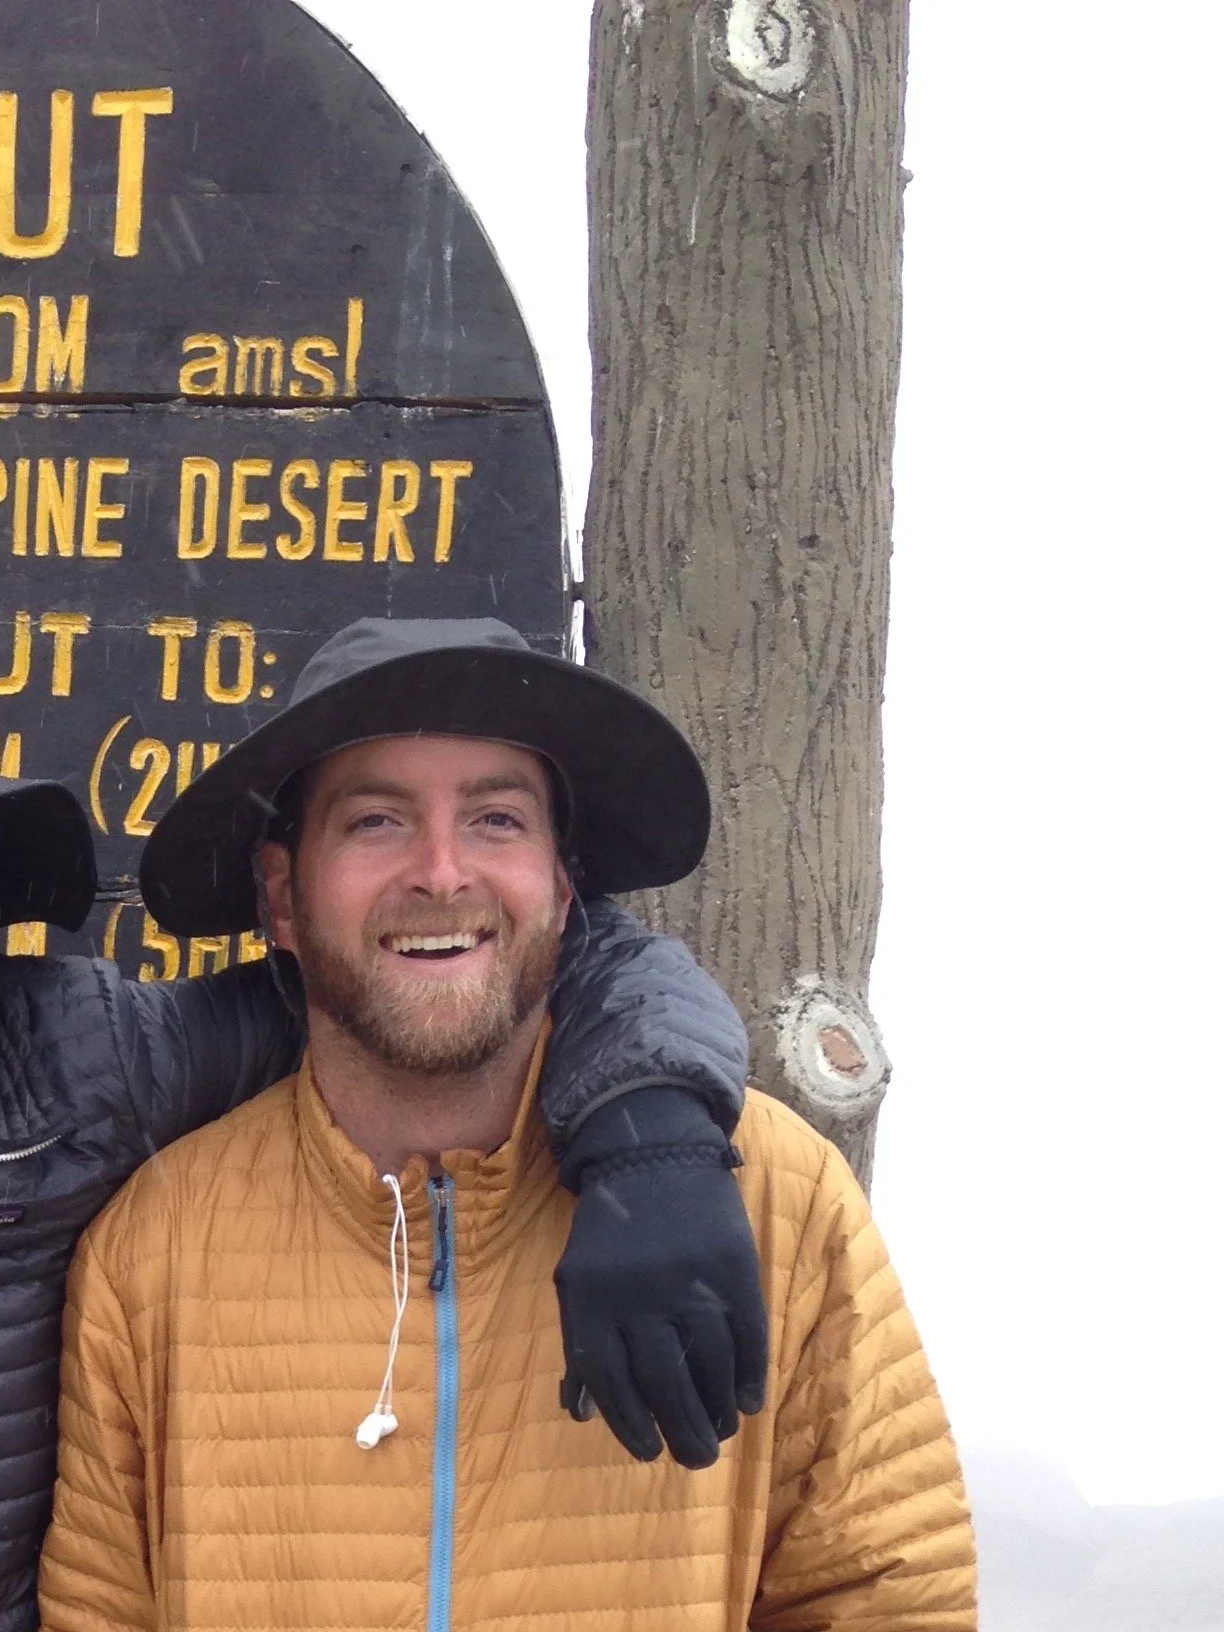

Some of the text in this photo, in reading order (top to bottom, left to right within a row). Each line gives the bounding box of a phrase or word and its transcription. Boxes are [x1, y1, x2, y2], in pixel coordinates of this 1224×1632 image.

[178, 298, 364, 402] amsl
[177, 456, 473, 563] DESERT
[148, 616, 277, 704] TO:
